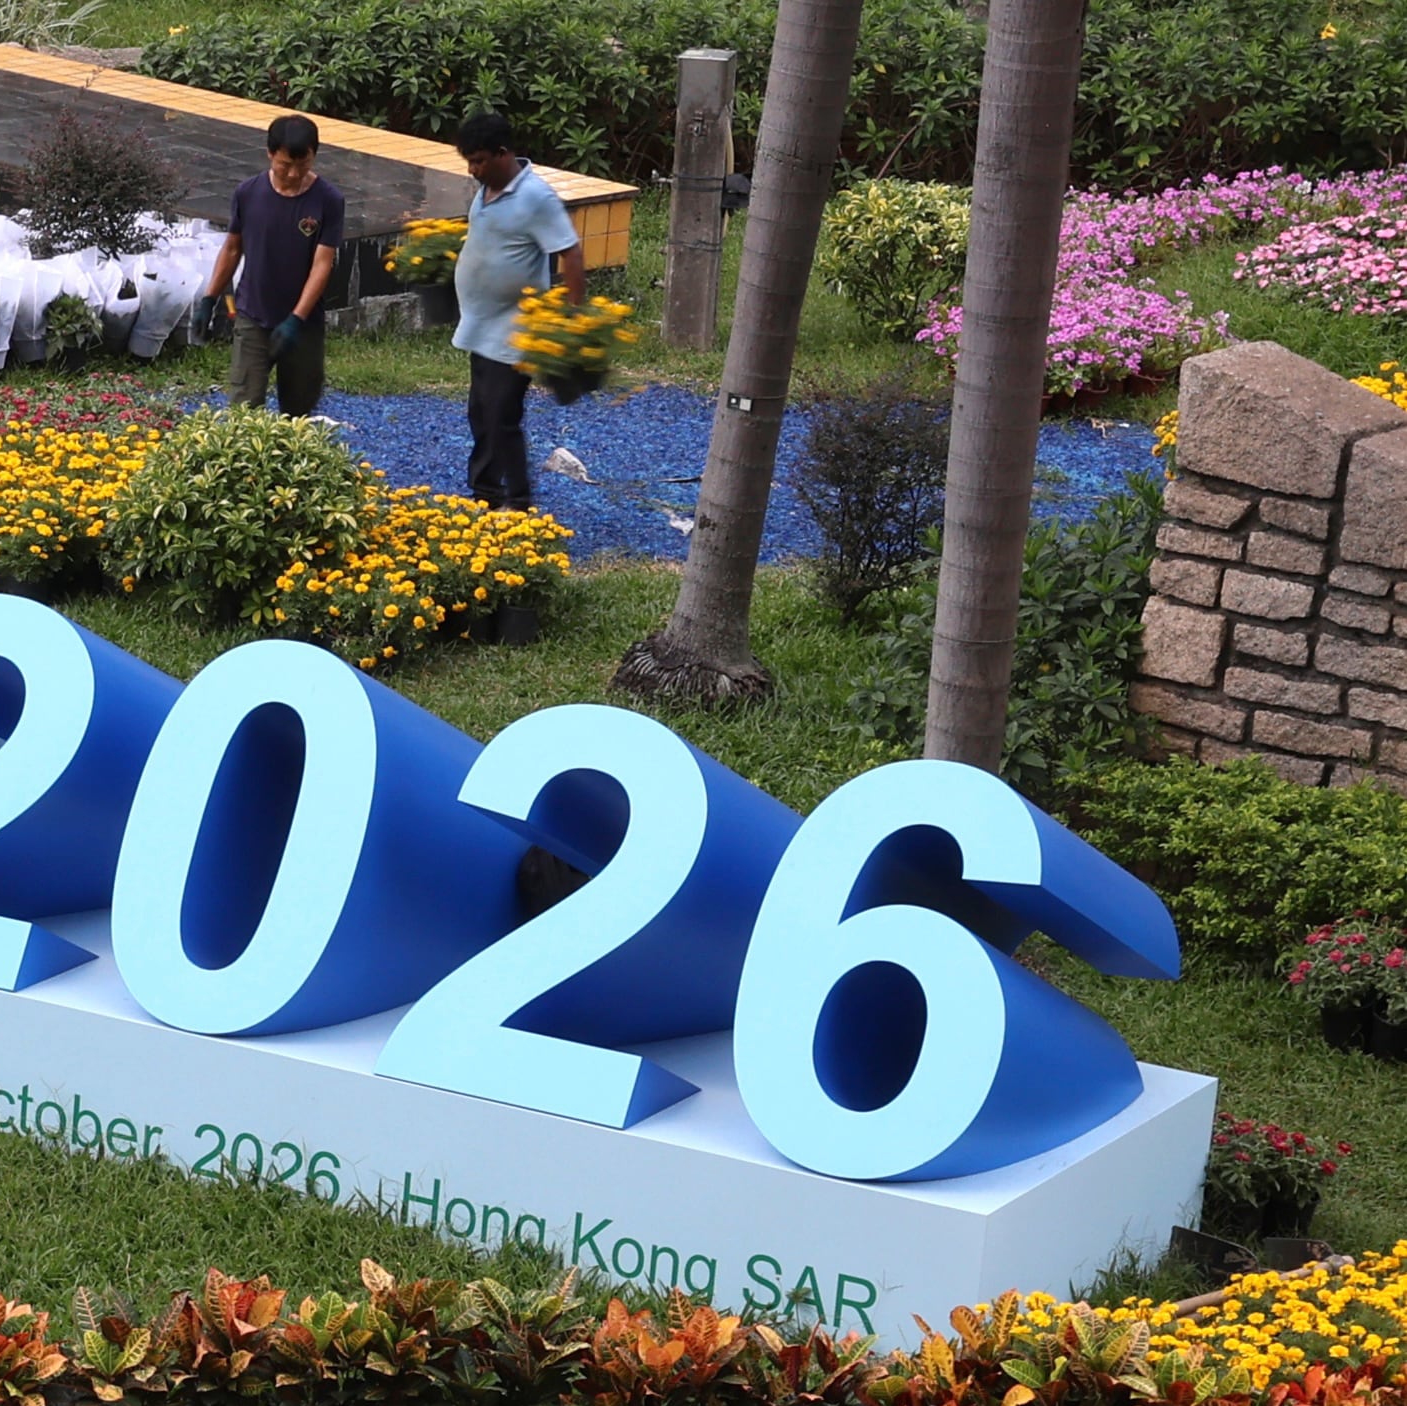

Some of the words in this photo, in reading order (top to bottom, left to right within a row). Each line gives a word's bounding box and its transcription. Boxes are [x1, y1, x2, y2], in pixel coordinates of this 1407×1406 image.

[193, 1123, 341, 1204] 2026
[400, 1171, 546, 1255] Hong
[571, 1212, 717, 1305] Kong
[742, 1254, 877, 1335] SAR
